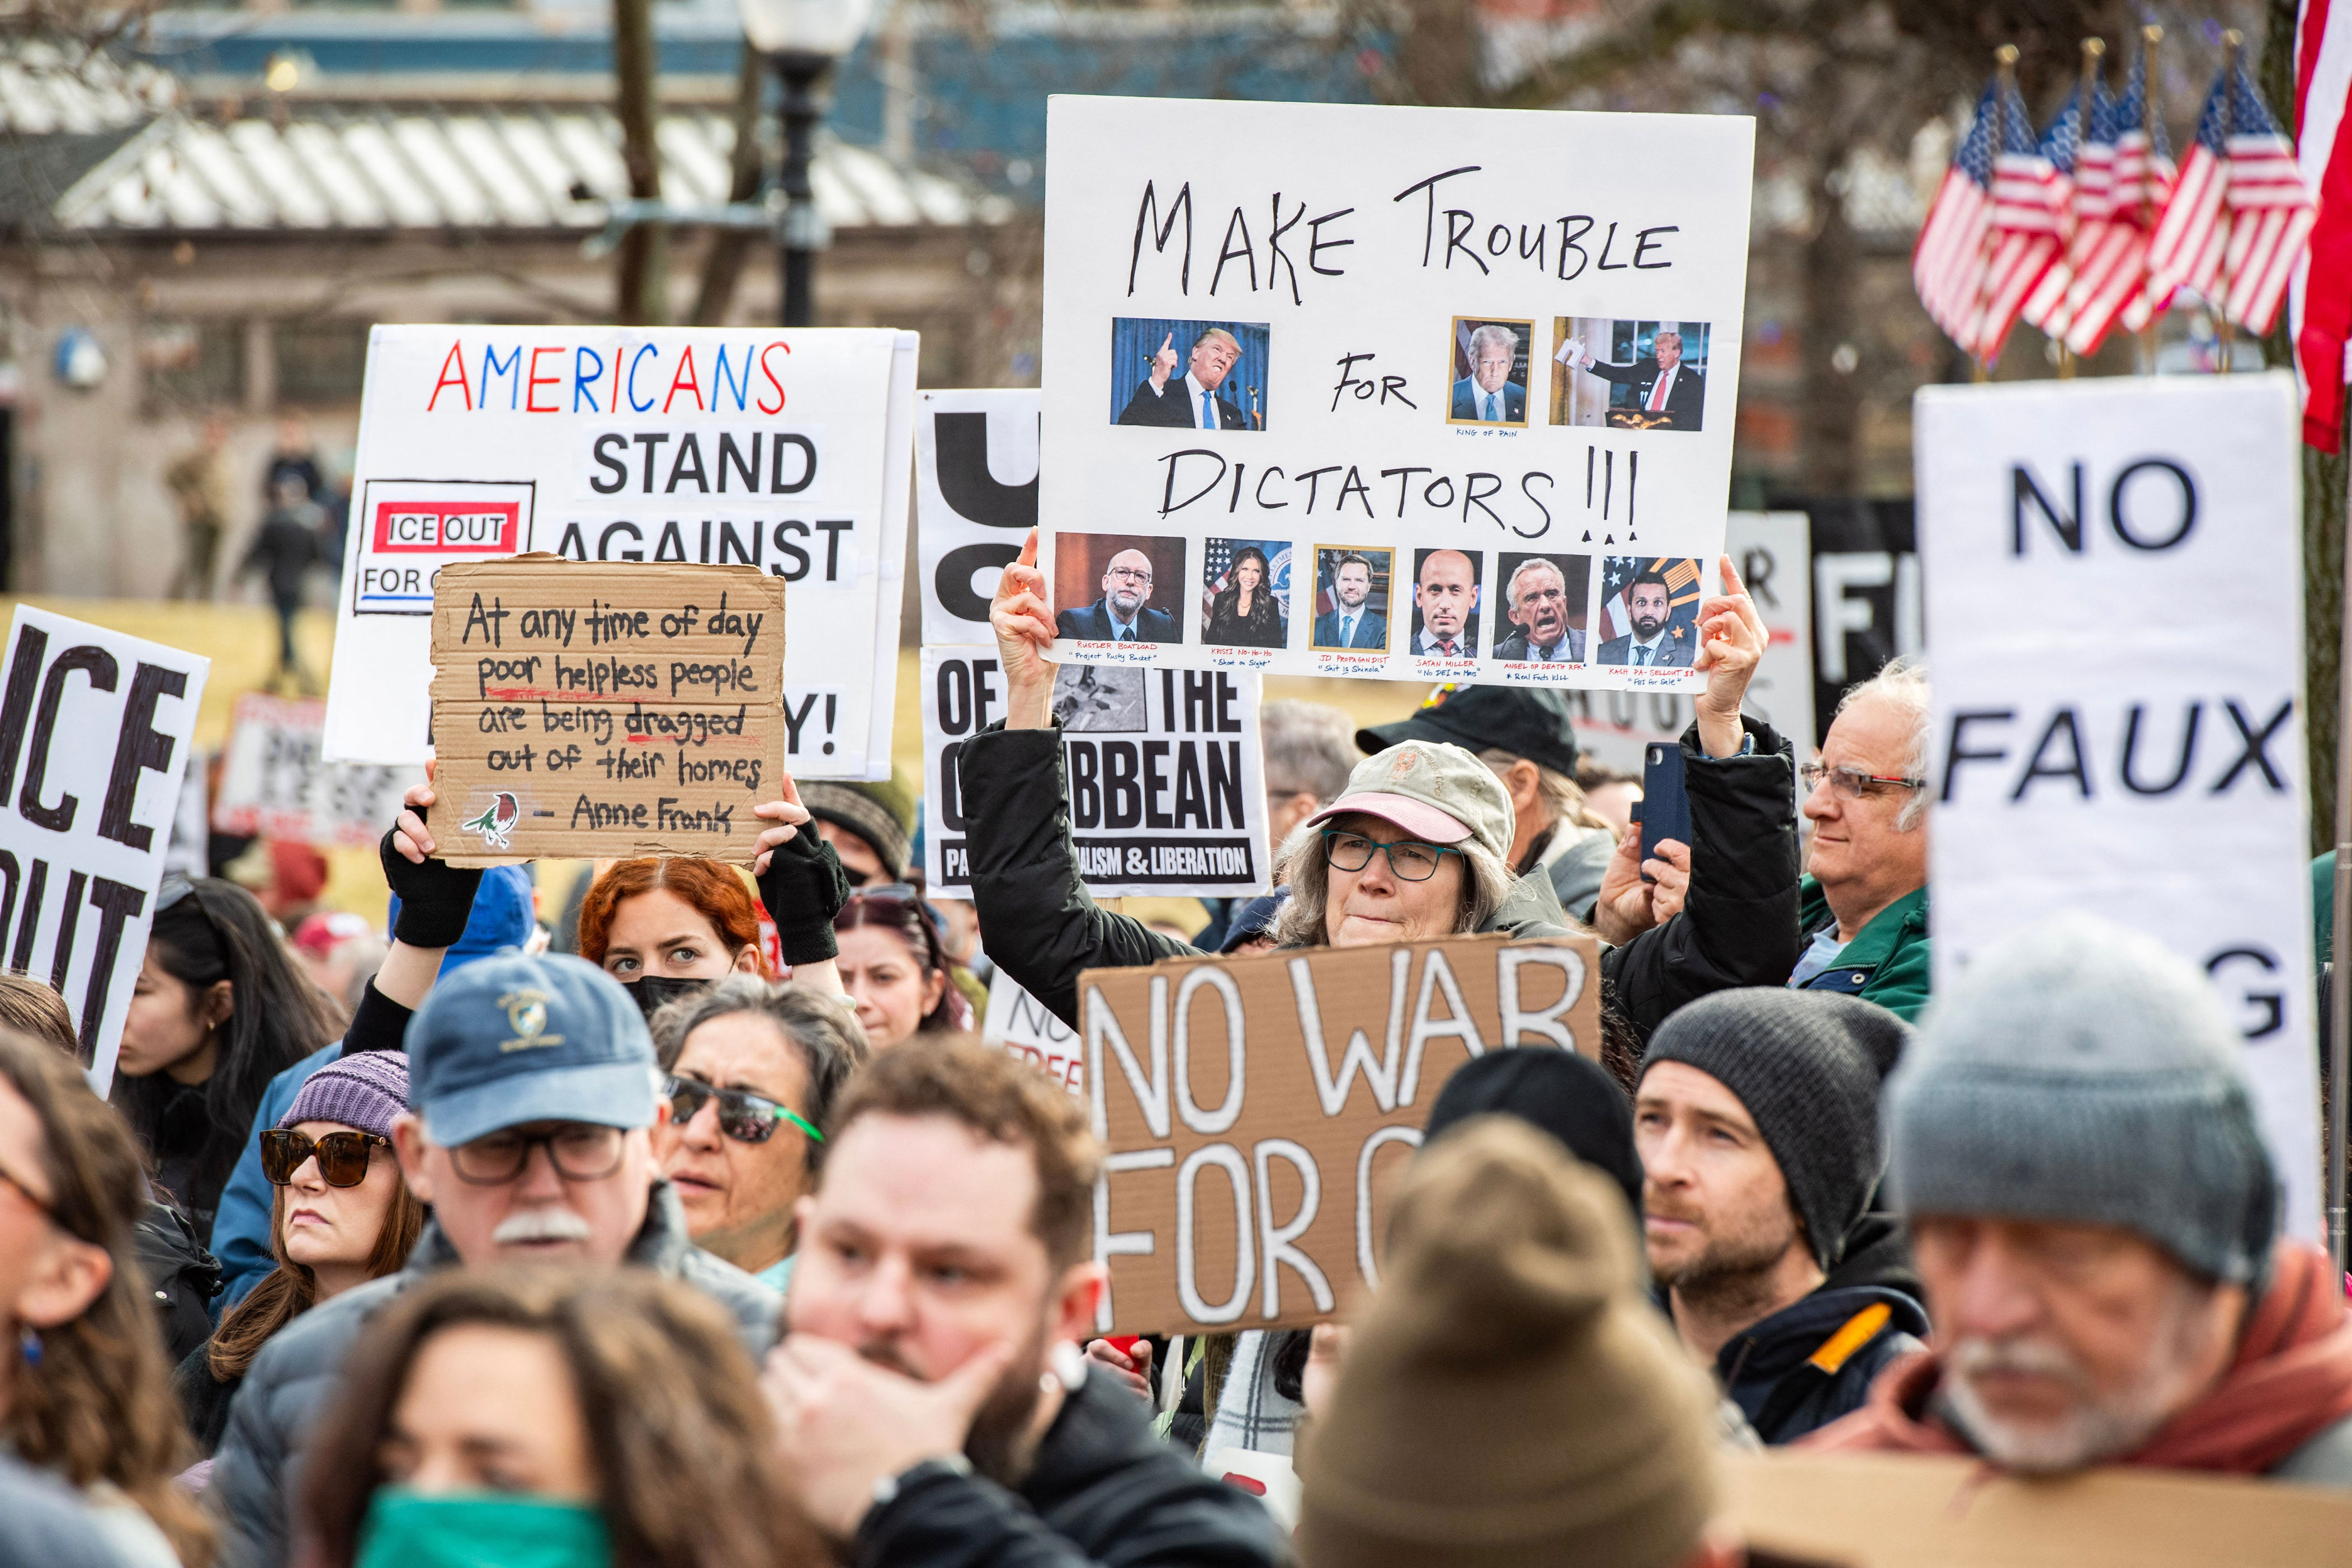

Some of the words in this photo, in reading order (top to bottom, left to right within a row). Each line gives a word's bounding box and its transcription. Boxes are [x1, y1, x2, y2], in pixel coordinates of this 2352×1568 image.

[1127, 179, 1356, 306] MAKE
[1394, 166, 1680, 281] TROUBLE
[427, 339, 791, 415] AMERICANS
[1331, 352, 1418, 411] FOR
[589, 432, 817, 495] STAND
[1457, 428, 1477, 436] KING
[390, 517, 436, 541] ICE
[445, 516, 506, 542] OUT
[2006, 456, 2200, 556] NO
[364, 569, 420, 592] FOR
[558, 519, 854, 583] AGAINST
[462, 592, 510, 648] At
[521, 608, 576, 648] any
[585, 599, 650, 645] time
[660, 604, 699, 637] of
[707, 591, 763, 658] day
[1077, 640, 1112, 649] RUSTLER
[478, 655, 541, 700] poor
[556, 654, 658, 696] helpless
[671, 658, 758, 697] people
[1107, 653, 1125, 662] Rusty
[479, 705, 526, 733] are
[542, 698, 613, 745] being
[625, 702, 745, 747] dragged
[938, 659, 998, 735] OF
[1154, 668, 1241, 733] THE
[0, 624, 189, 853] ICE
[488, 744, 537, 772] out
[546, 744, 582, 771] of
[597, 748, 665, 782] their
[678, 749, 762, 790] homes
[1938, 699, 2295, 804] FAUX
[570, 794, 648, 830] Anne
[658, 797, 734, 837] Frank
[941, 740, 1245, 830] CBBEAN
[1075, 846, 1122, 876] ALISM
[1126, 847, 1150, 876] &
[1150, 846, 1248, 876] LIBERATION
[1087, 965, 1246, 1140] NO
[1287, 945, 1588, 1115] WAR
[1092, 1138, 1336, 1334] FOR
